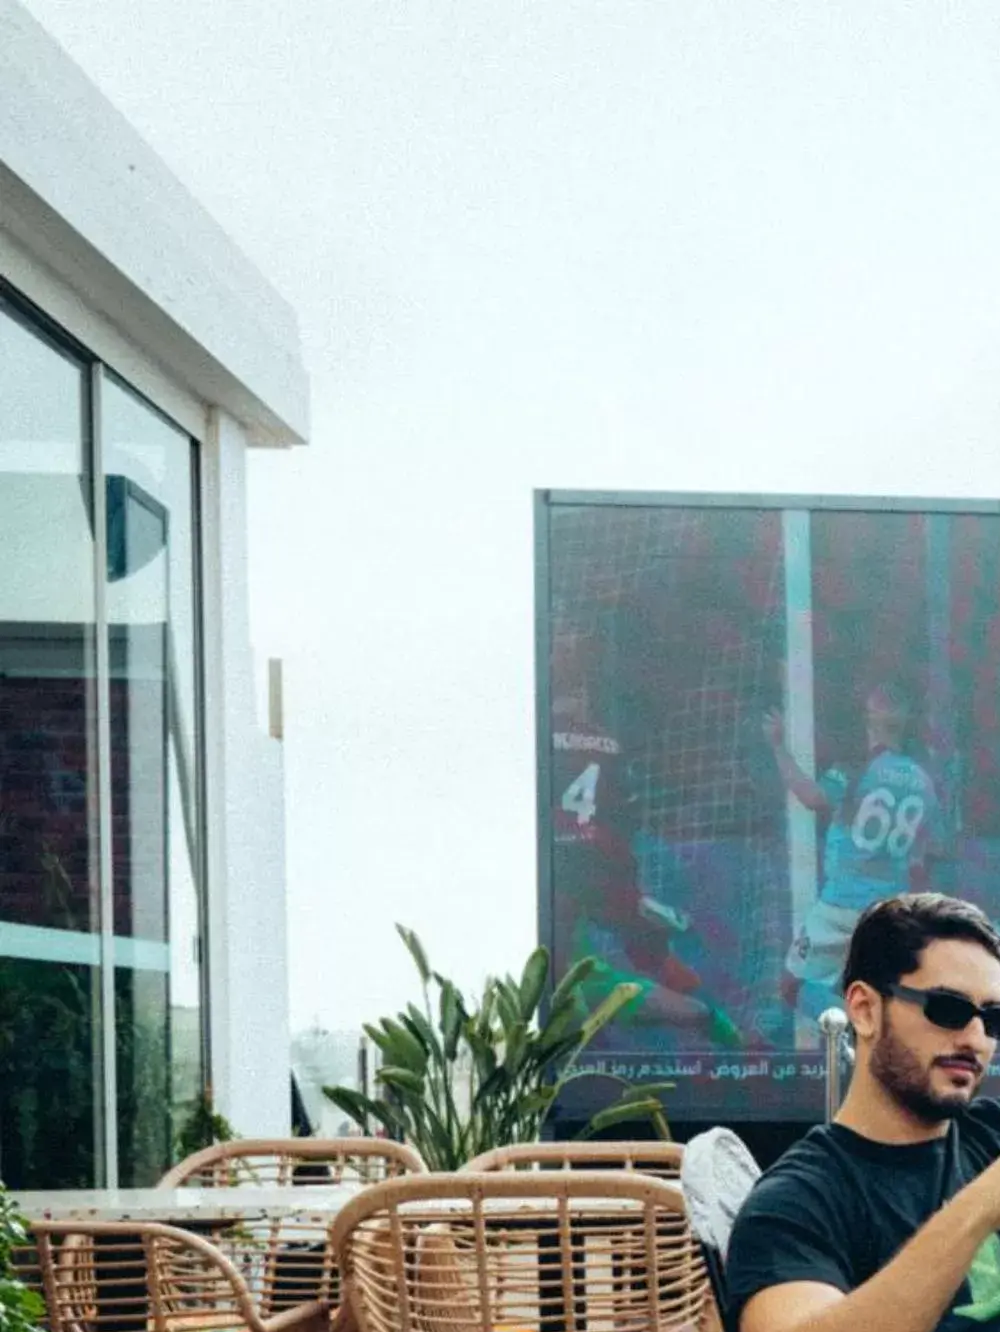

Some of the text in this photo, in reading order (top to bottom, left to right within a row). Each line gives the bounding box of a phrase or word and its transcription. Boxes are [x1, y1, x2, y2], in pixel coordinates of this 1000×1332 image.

[562, 763, 600, 824] 4
[852, 788, 924, 857] 68
[772, 1063, 796, 1081] عن
